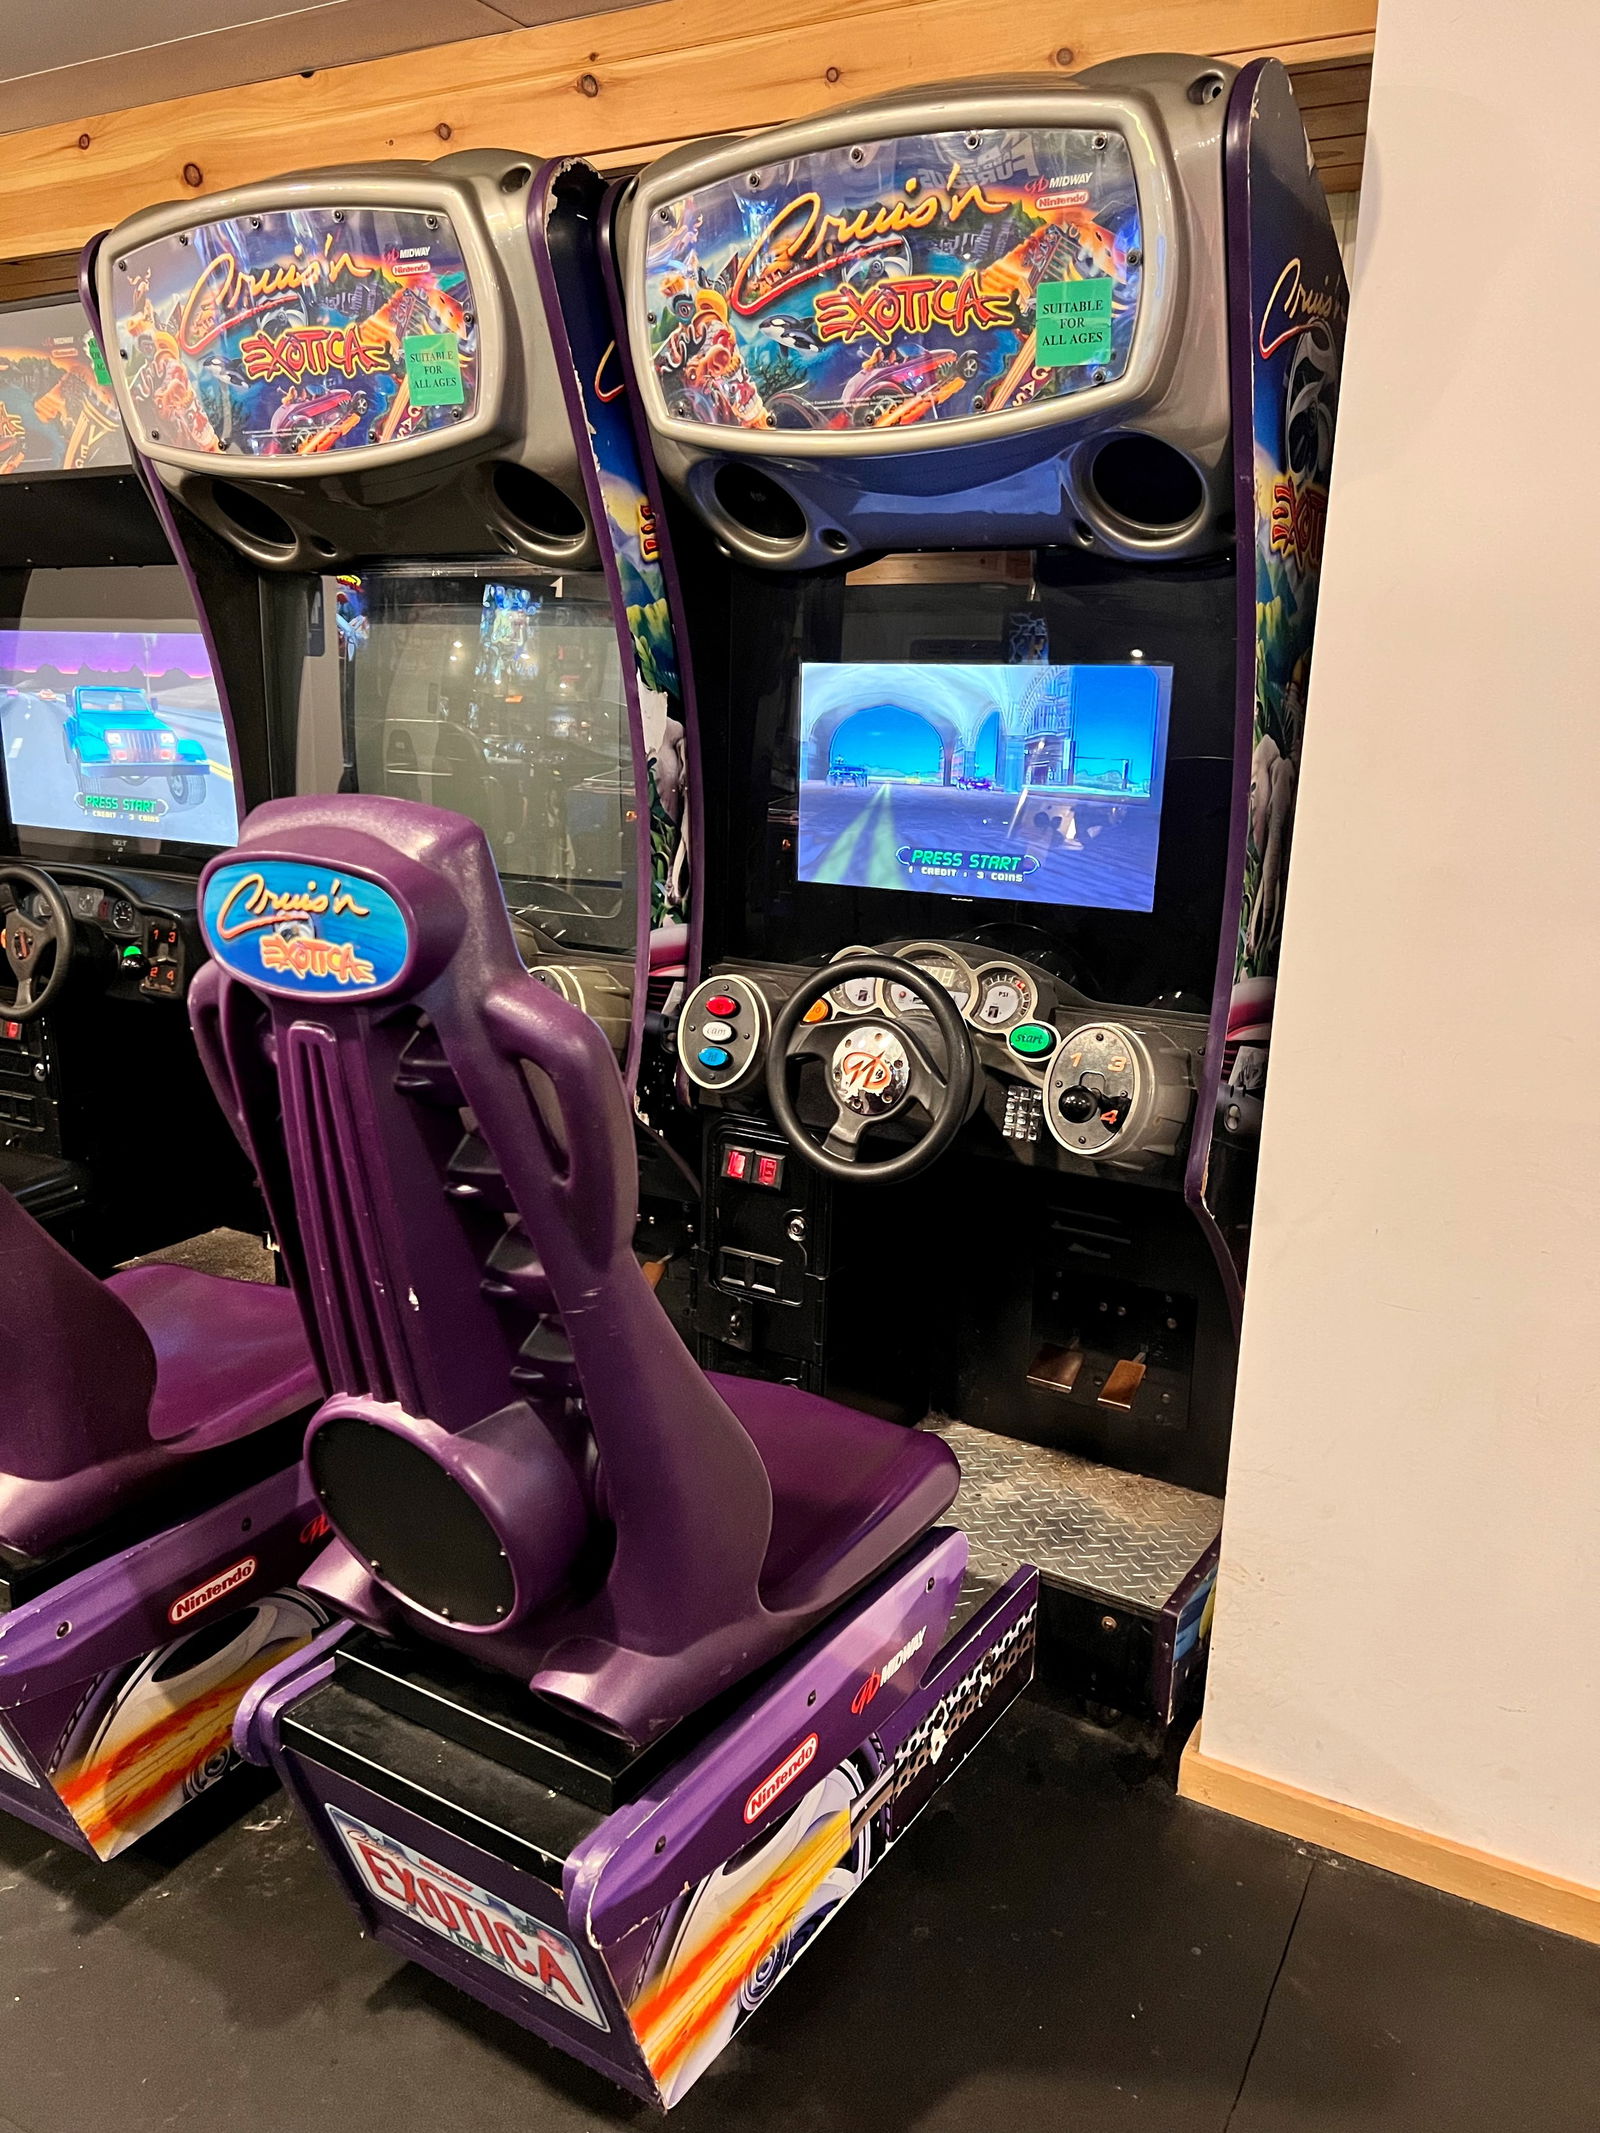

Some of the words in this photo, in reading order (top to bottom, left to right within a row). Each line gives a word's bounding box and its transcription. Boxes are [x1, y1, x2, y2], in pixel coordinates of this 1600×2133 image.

[1049, 172, 1094, 189] MIDWAY
[1038, 192, 1087, 208] Nintendo
[399, 246, 431, 260] MIDWAY
[394, 262, 429, 275] Nintendo
[815, 269, 1013, 345] EXOTICA
[1042, 299, 1104, 315] SUITABLE
[1059, 317, 1085, 329] FOR
[1042, 335, 1067, 346] ALL
[1069, 331, 1103, 345] AGES
[240, 323, 390, 384] EXOTICA
[410, 350, 454, 363] SUITABLE
[424, 364, 443, 375] FOR
[413, 378, 432, 390] ALL
[433, 377, 457, 388] AGES
[84, 795, 119, 810] PRESS
[122, 798, 157, 813] START
[92, 810, 117, 819] CREDIT
[912, 849, 963, 867] PRESS
[969, 853, 1022, 871] START
[921, 866, 958, 878] CREDIT
[976, 871, 985, 880] 3
[216, 873, 370, 940] Cruis'n
[153, 929, 160, 940] 1
[168, 931, 177, 943] 3
[259, 933, 377, 984] EXOTICA
[150, 966, 159, 977] 2
[166, 970, 175, 981] 4
[706, 1026, 726, 1036] cam
[1016, 1032, 1044, 1045] start
[1070, 1052, 1082, 1068] 1
[1107, 1056, 1127, 1072] 3
[1100, 1109, 1119, 1124] 4
[175, 1560, 255, 1618] Nintendo
[880, 1625, 928, 1687] MIDWAY
[749, 1740, 815, 1815] Nintendo
[357, 1842, 584, 2005] EXOTICA
